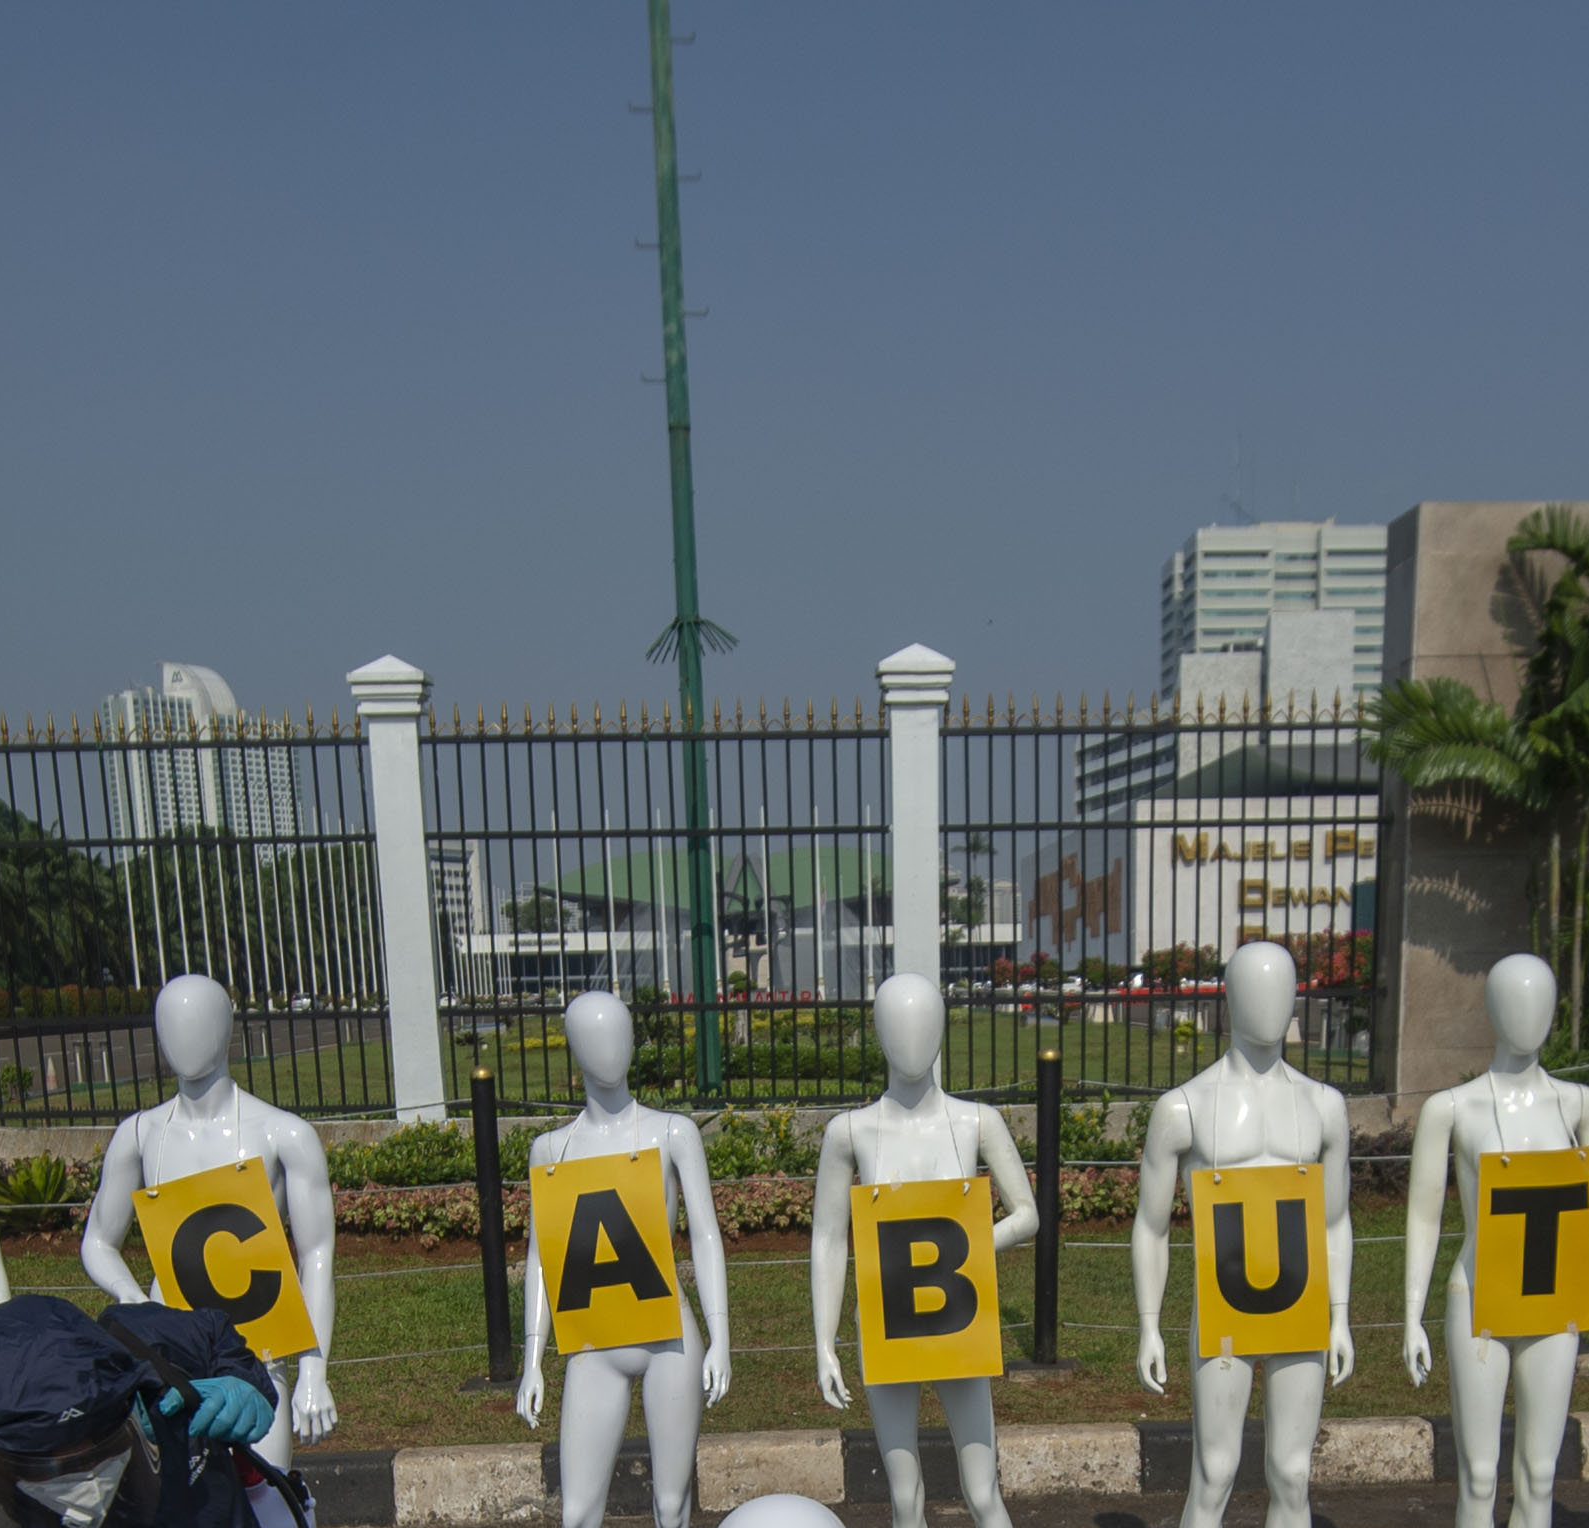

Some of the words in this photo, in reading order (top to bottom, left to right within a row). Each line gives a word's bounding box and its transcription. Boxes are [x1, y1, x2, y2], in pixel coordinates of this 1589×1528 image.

[171, 1204, 281, 1324] C
[557, 1190, 671, 1312] A
[878, 1218, 977, 1339] B
[1214, 1200, 1307, 1314] U
[1491, 1183, 1589, 1296] T
